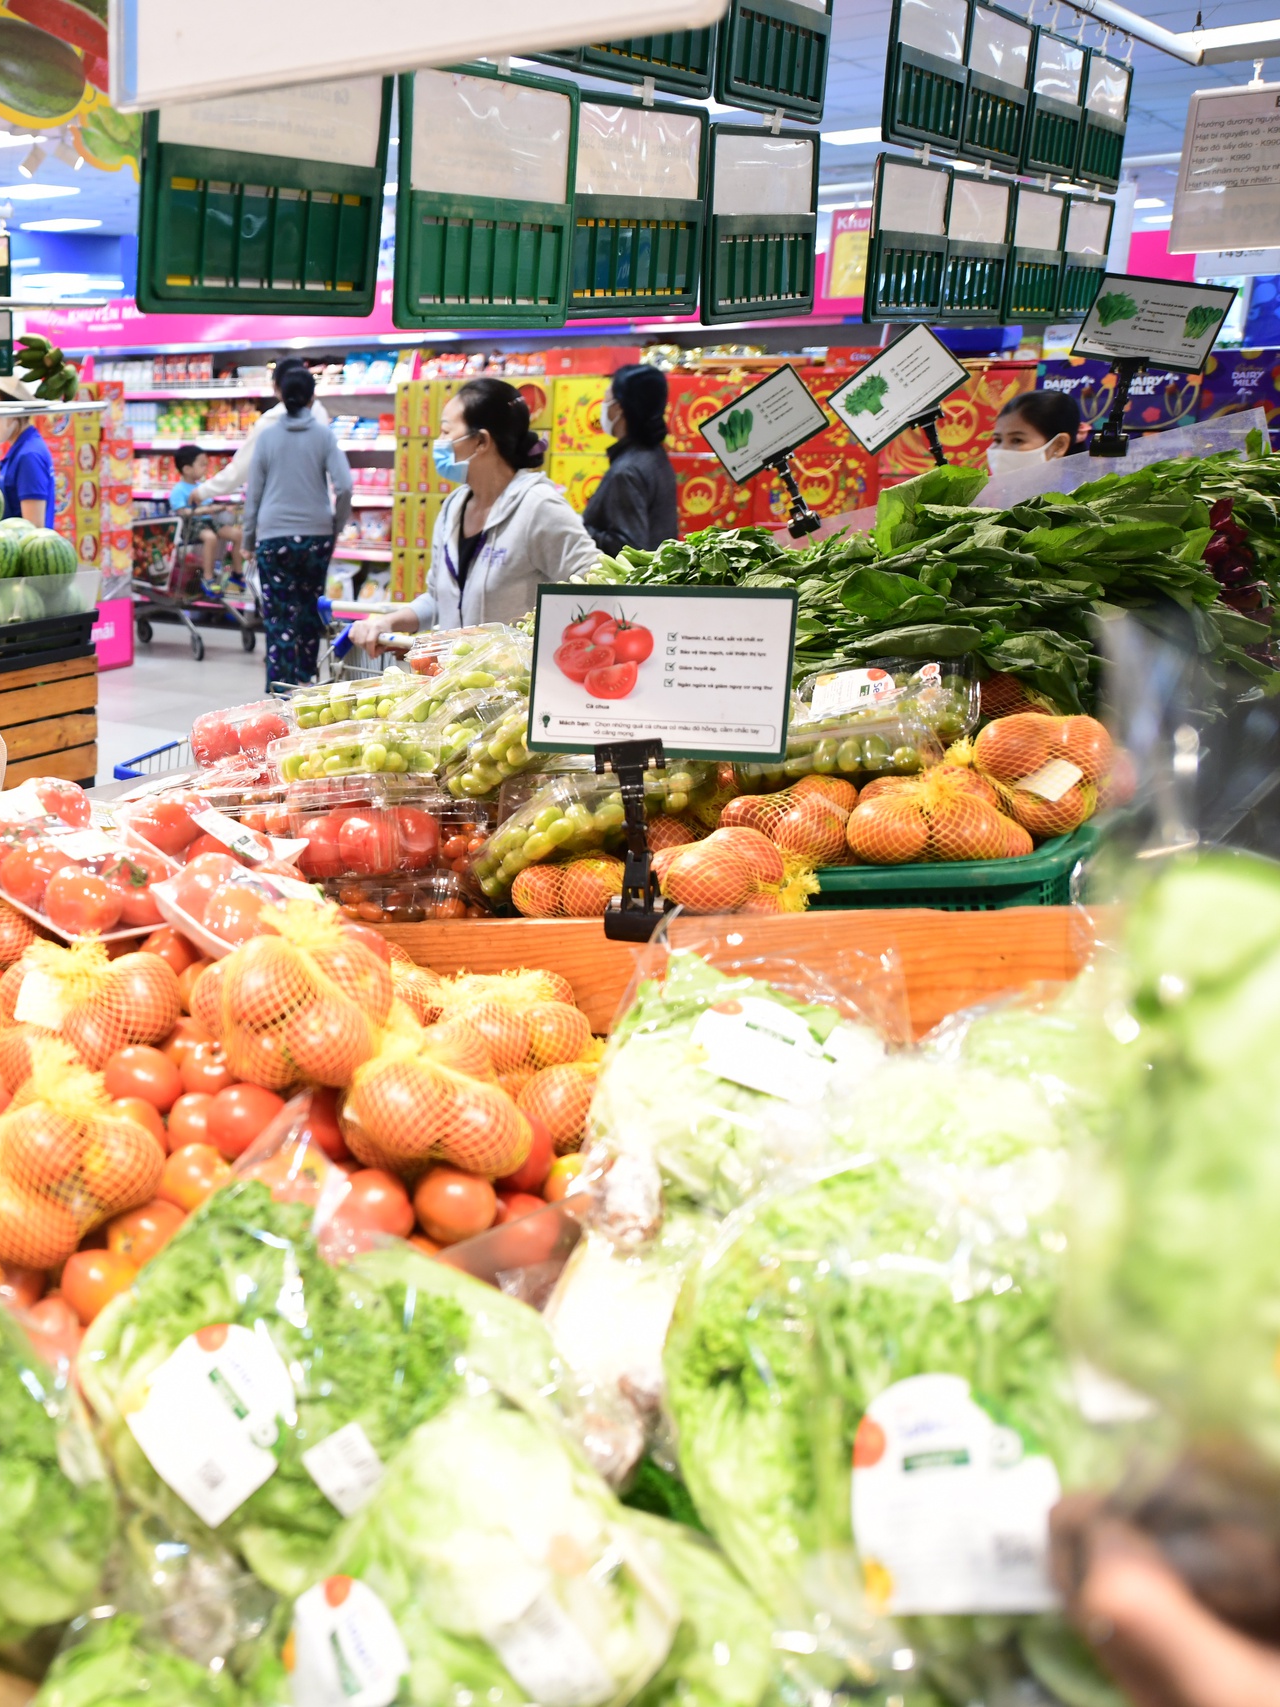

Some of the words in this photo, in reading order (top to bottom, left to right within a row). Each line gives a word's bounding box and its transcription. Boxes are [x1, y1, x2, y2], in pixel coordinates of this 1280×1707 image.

[1255, 114, 1280, 124] nguyê
[1230, 153, 1251, 161] K990
[1231, 371, 1265, 380] DAIRY
[1043, 378, 1080, 390] DAIRY
[1131, 375, 1165, 387] AIRY
[1233, 379, 1259, 387] MILK
[612, 721, 631, 729] những
[601, 729, 616, 737] căng
